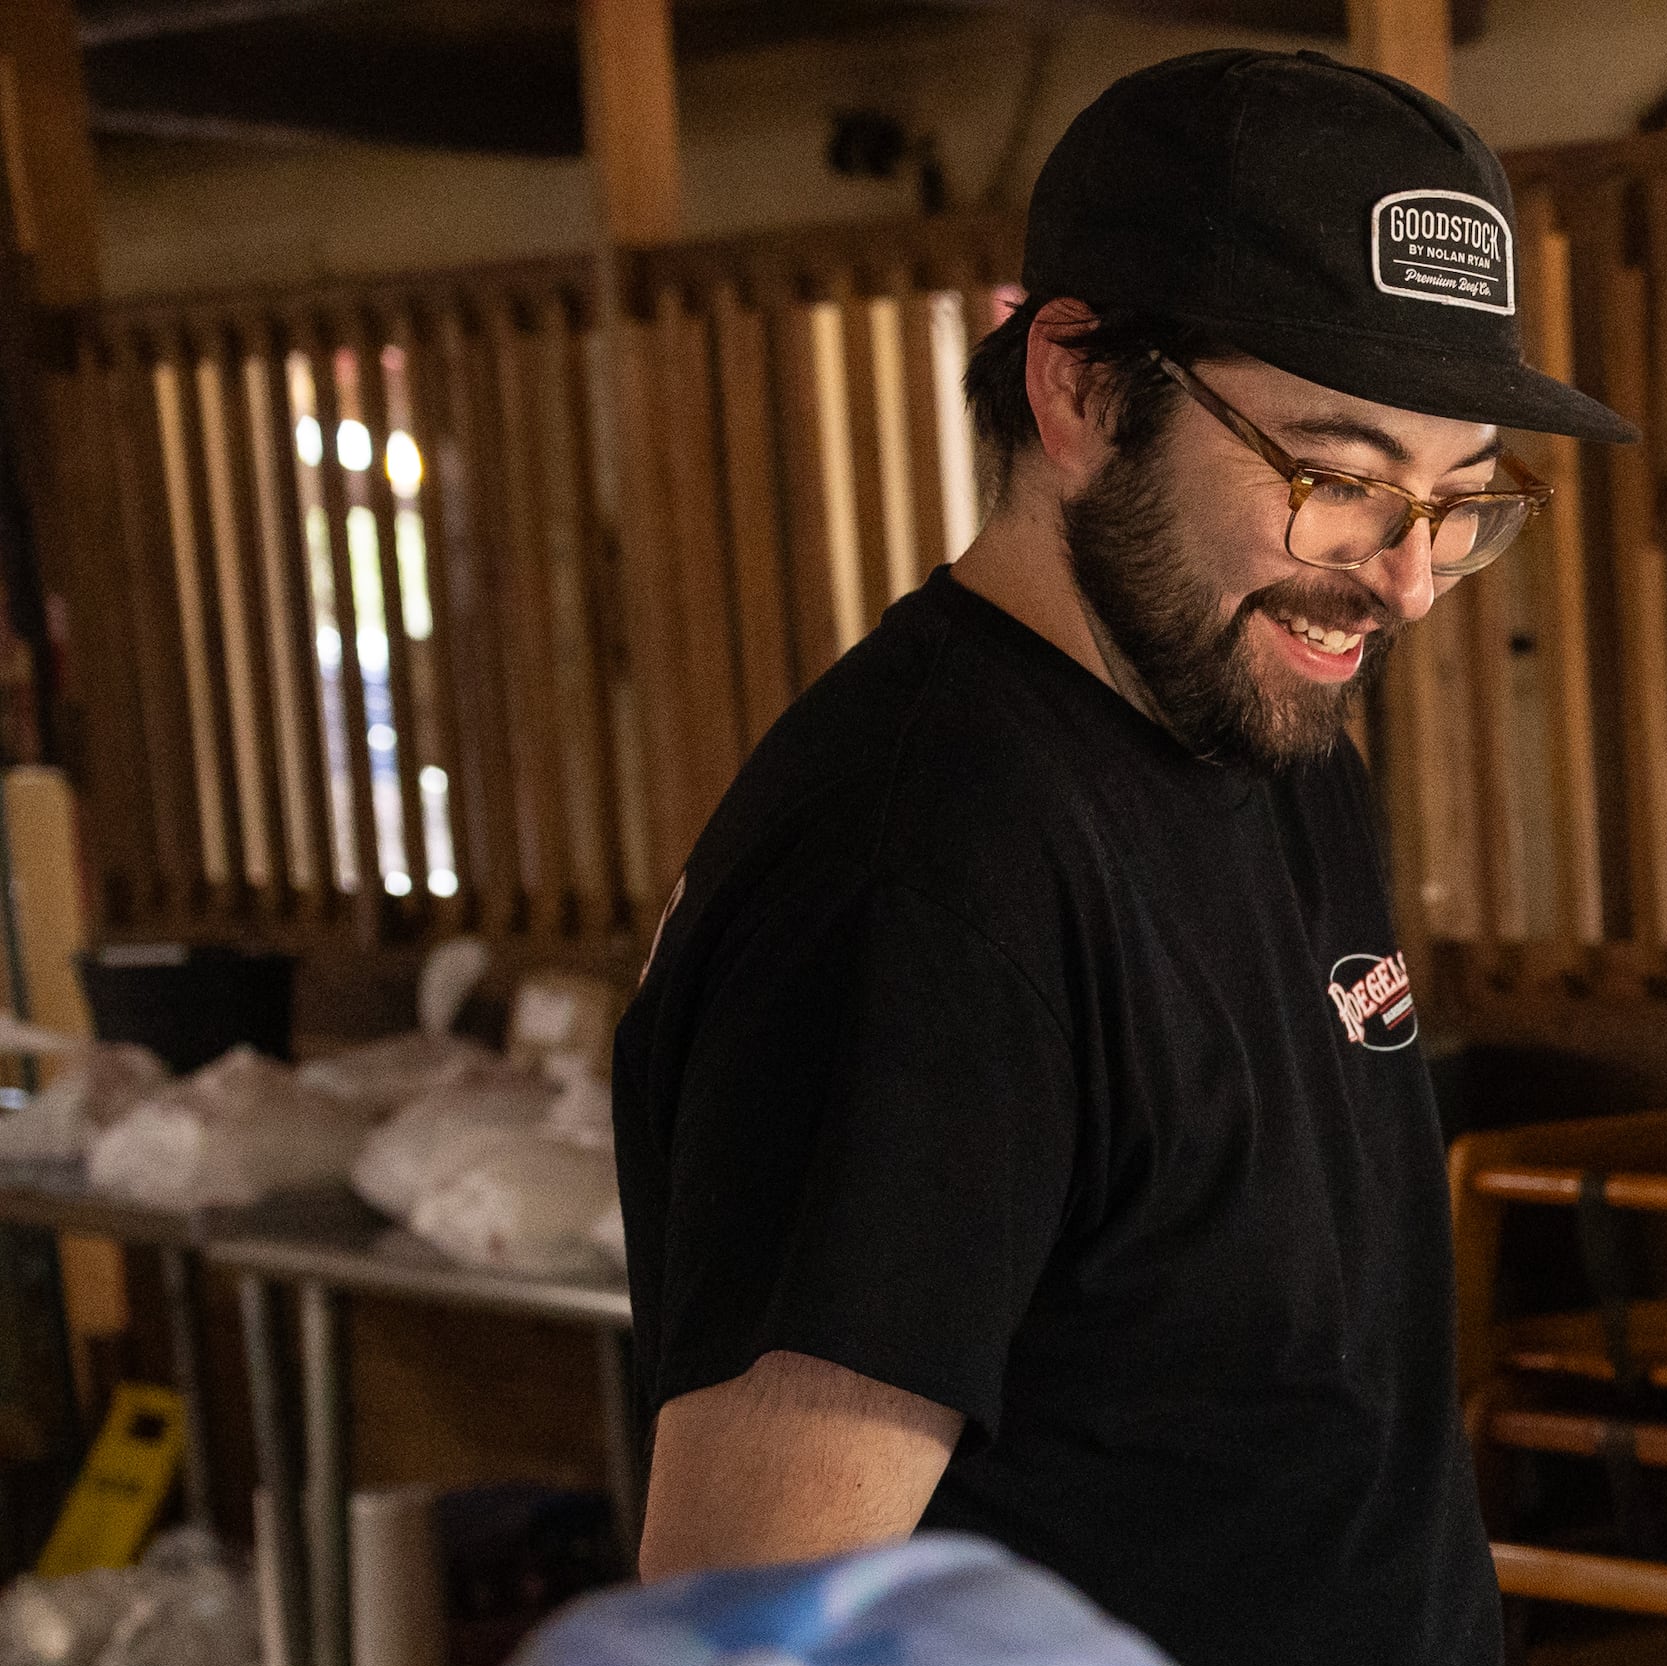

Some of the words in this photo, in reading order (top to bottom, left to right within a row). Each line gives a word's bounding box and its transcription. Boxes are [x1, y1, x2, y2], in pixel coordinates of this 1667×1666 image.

[1390, 205, 1501, 262] GOODSTOCK
[1409, 244, 1424, 256] BY
[1426, 247, 1466, 265] NOLAN
[1467, 255, 1491, 270] RYAN
[1404, 268, 1458, 289] Premium
[1458, 277, 1479, 297] Beef
